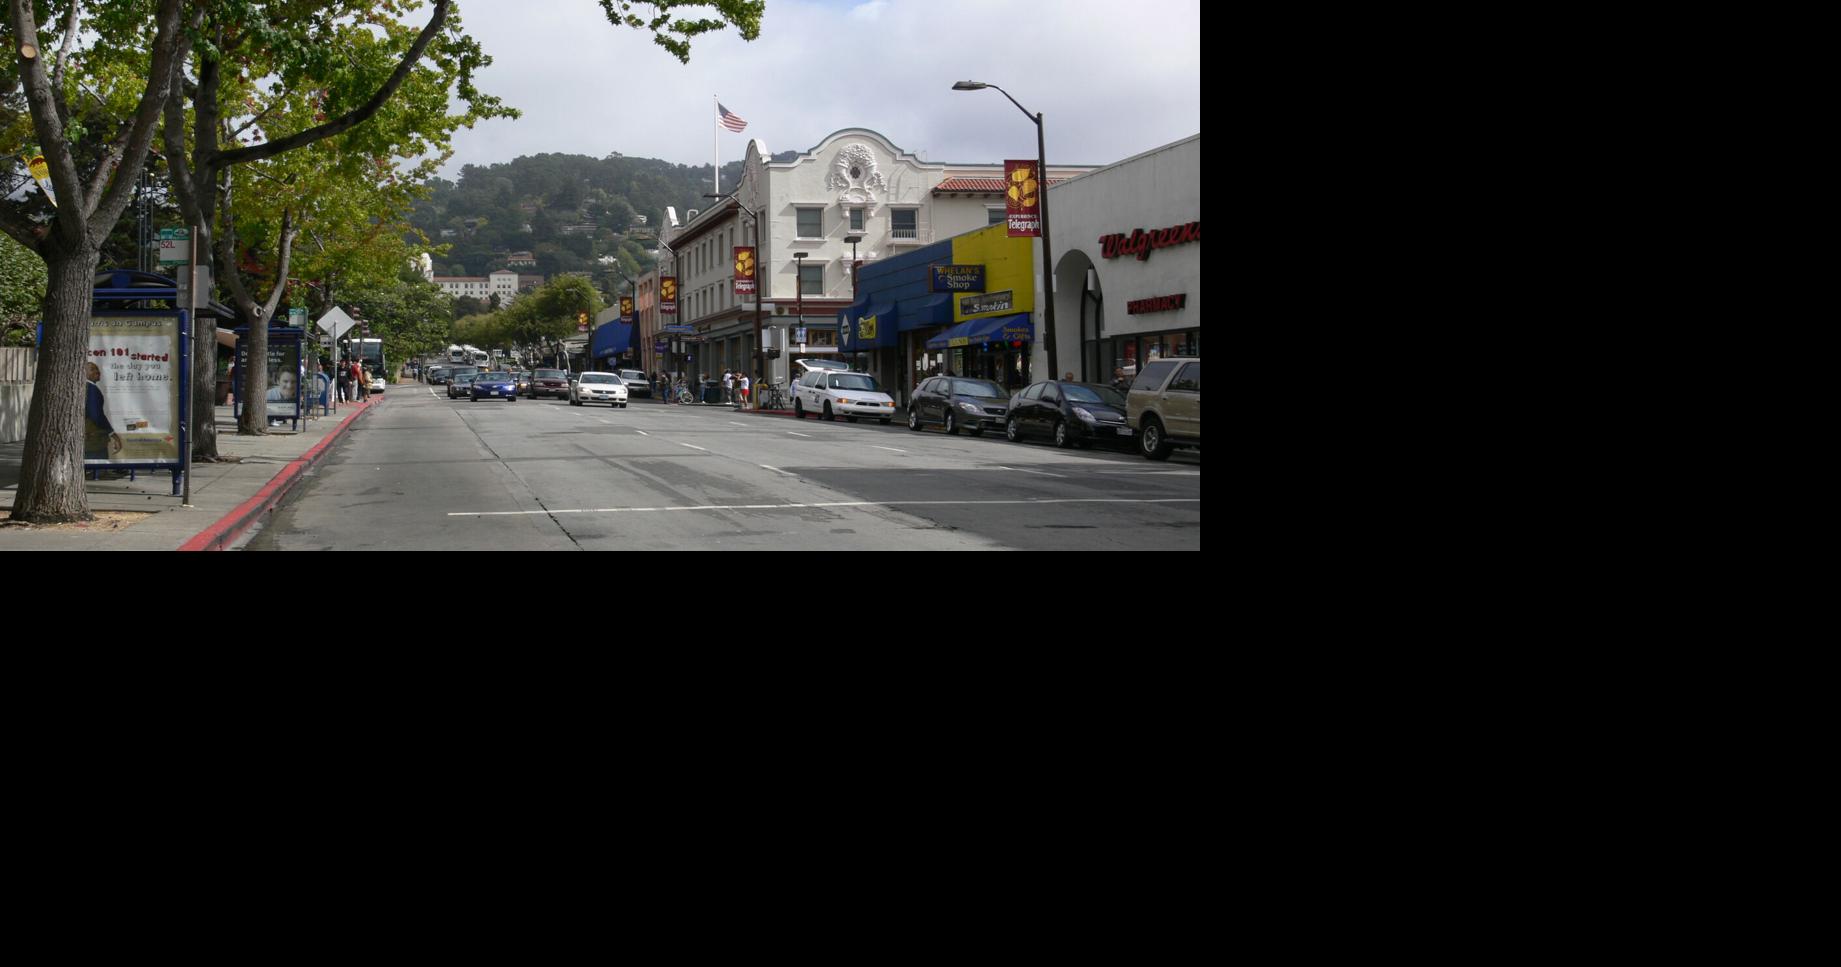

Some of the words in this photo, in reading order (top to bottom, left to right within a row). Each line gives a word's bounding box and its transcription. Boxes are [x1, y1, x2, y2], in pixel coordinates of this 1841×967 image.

[1007, 219, 1040, 231] Telegraph
[946, 273, 977, 282] Smoke
[946, 281, 970, 290] Shop
[1127, 293, 1187, 315] PHARMACY
[111, 348, 129, 357] 101
[131, 353, 168, 362] started
[113, 372, 134, 381] left
